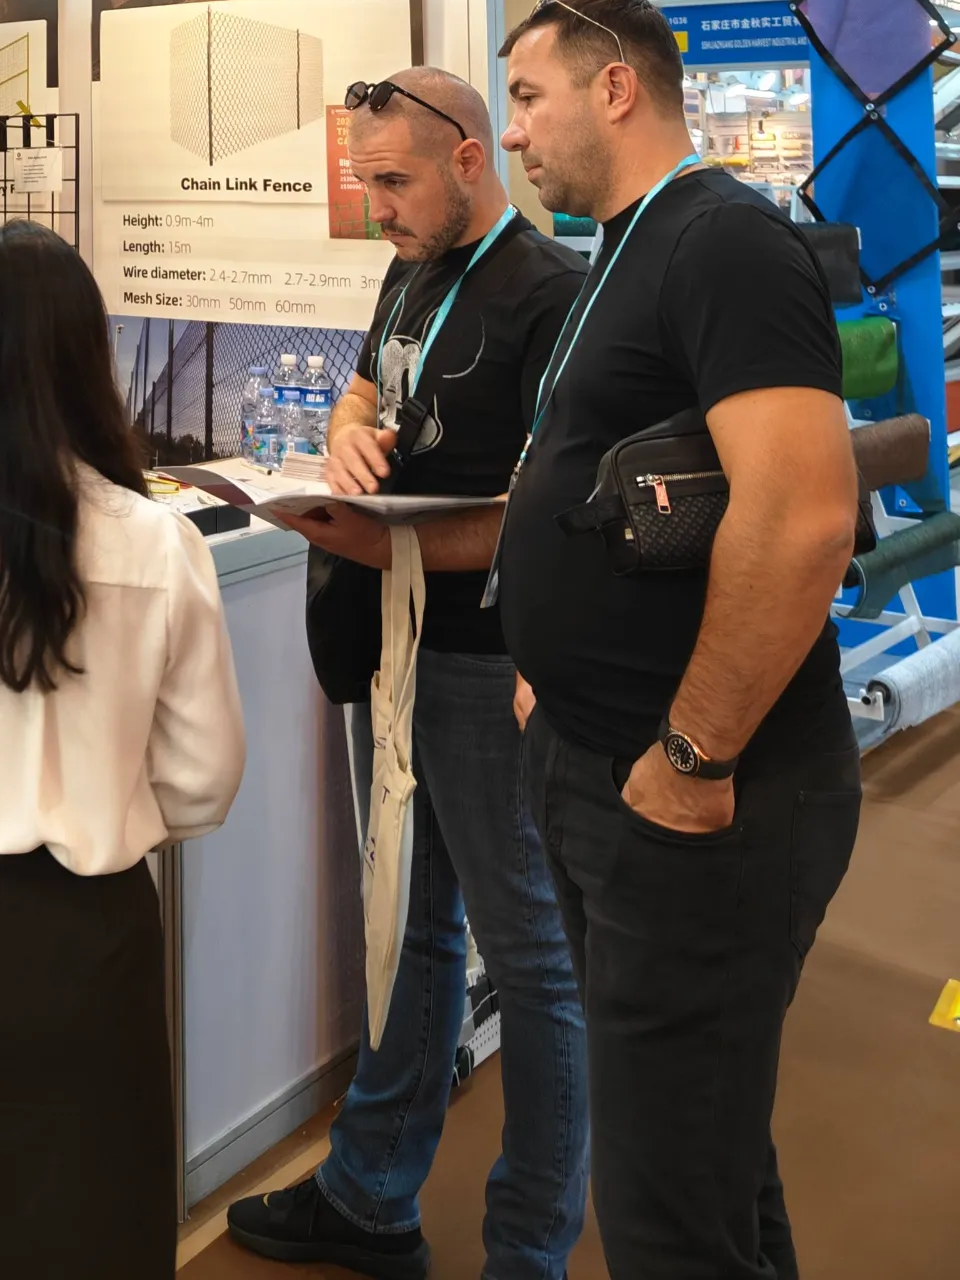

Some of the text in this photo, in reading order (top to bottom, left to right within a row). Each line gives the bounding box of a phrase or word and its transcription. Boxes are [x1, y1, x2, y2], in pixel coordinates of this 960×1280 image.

[181, 178, 312, 192] Chain Link Fence
[123, 214, 214, 229] Height: 0.9m-4m
[123, 240, 191, 255] Length: 15m
[123, 266, 351, 288] Wire diameter: 2.4-2.7mm 2.7-2.9mm
[123, 291, 316, 314] Mesh Size: 30mm 50mm 60mm
